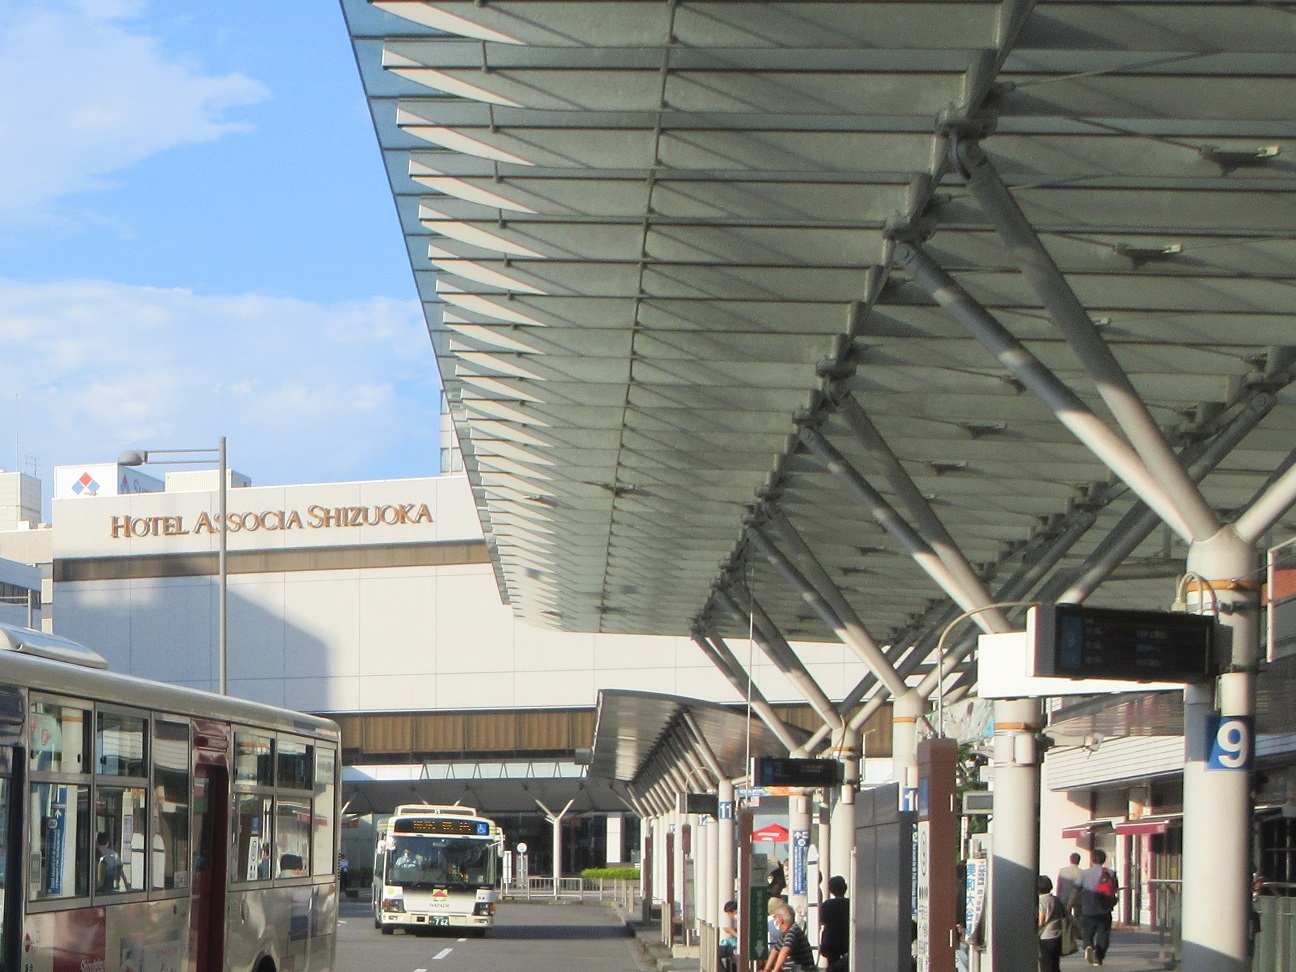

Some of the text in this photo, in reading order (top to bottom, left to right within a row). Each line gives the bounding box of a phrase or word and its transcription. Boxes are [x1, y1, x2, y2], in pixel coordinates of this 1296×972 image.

[109, 514, 190, 538] HOTEL
[306, 502, 434, 529] SHIZUOKA
[1215, 720, 1248, 768] 9
[720, 803, 732, 818] 11
